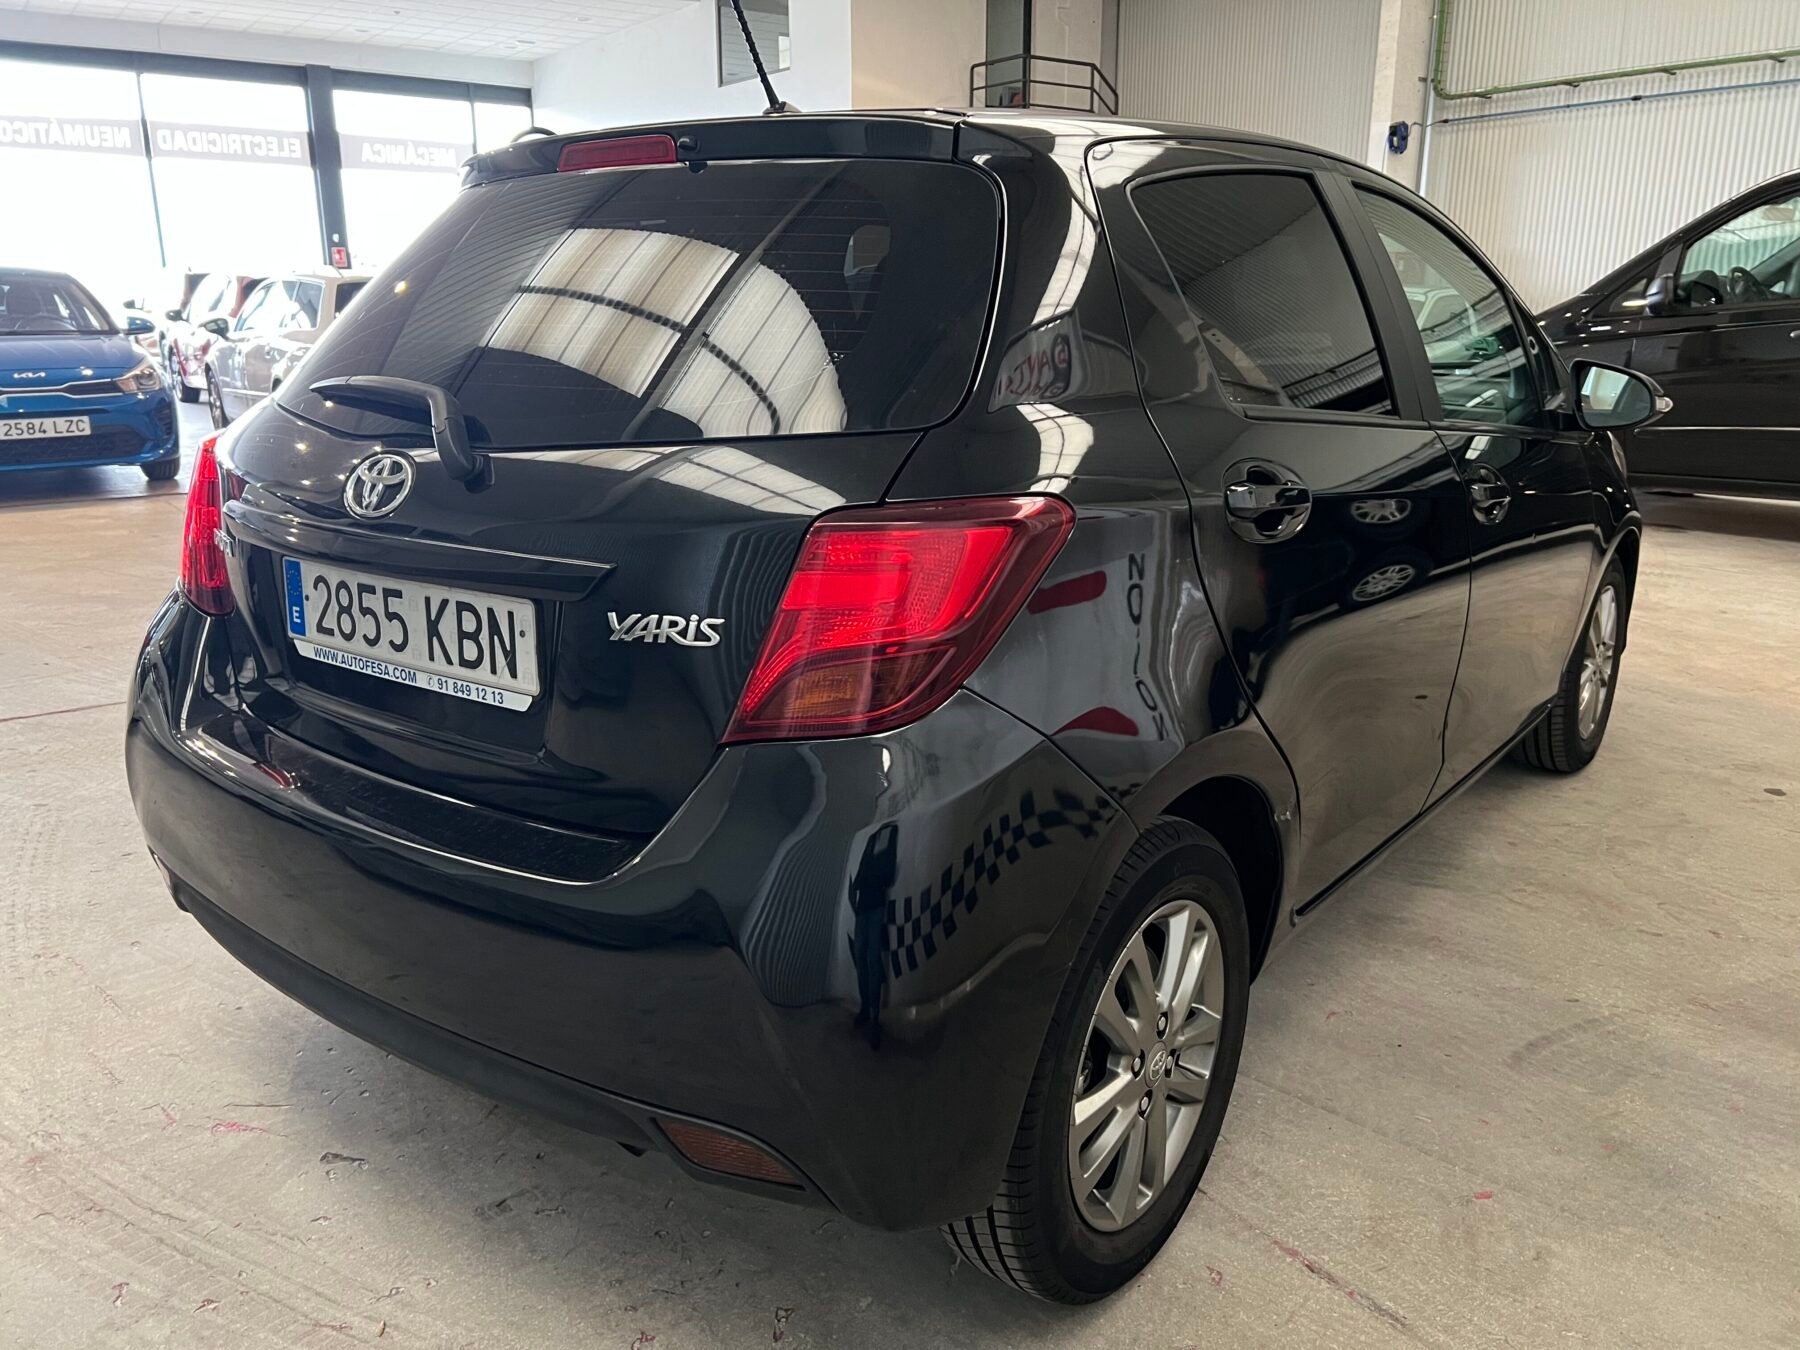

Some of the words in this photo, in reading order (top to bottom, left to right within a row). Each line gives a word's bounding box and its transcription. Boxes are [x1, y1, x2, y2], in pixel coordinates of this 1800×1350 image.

[3, 421, 47, 437] 2584
[53, 419, 86, 434] LZC
[292, 606, 301, 623] E
[312, 574, 409, 653] 2855
[424, 596, 518, 680] KBN
[313, 646, 417, 684] WWW.AUTOFESA.COM
[437, 678, 449, 692] 91
[453, 681, 471, 697] 849
[475, 687, 488, 701] 12
[491, 690, 504, 705] 13
